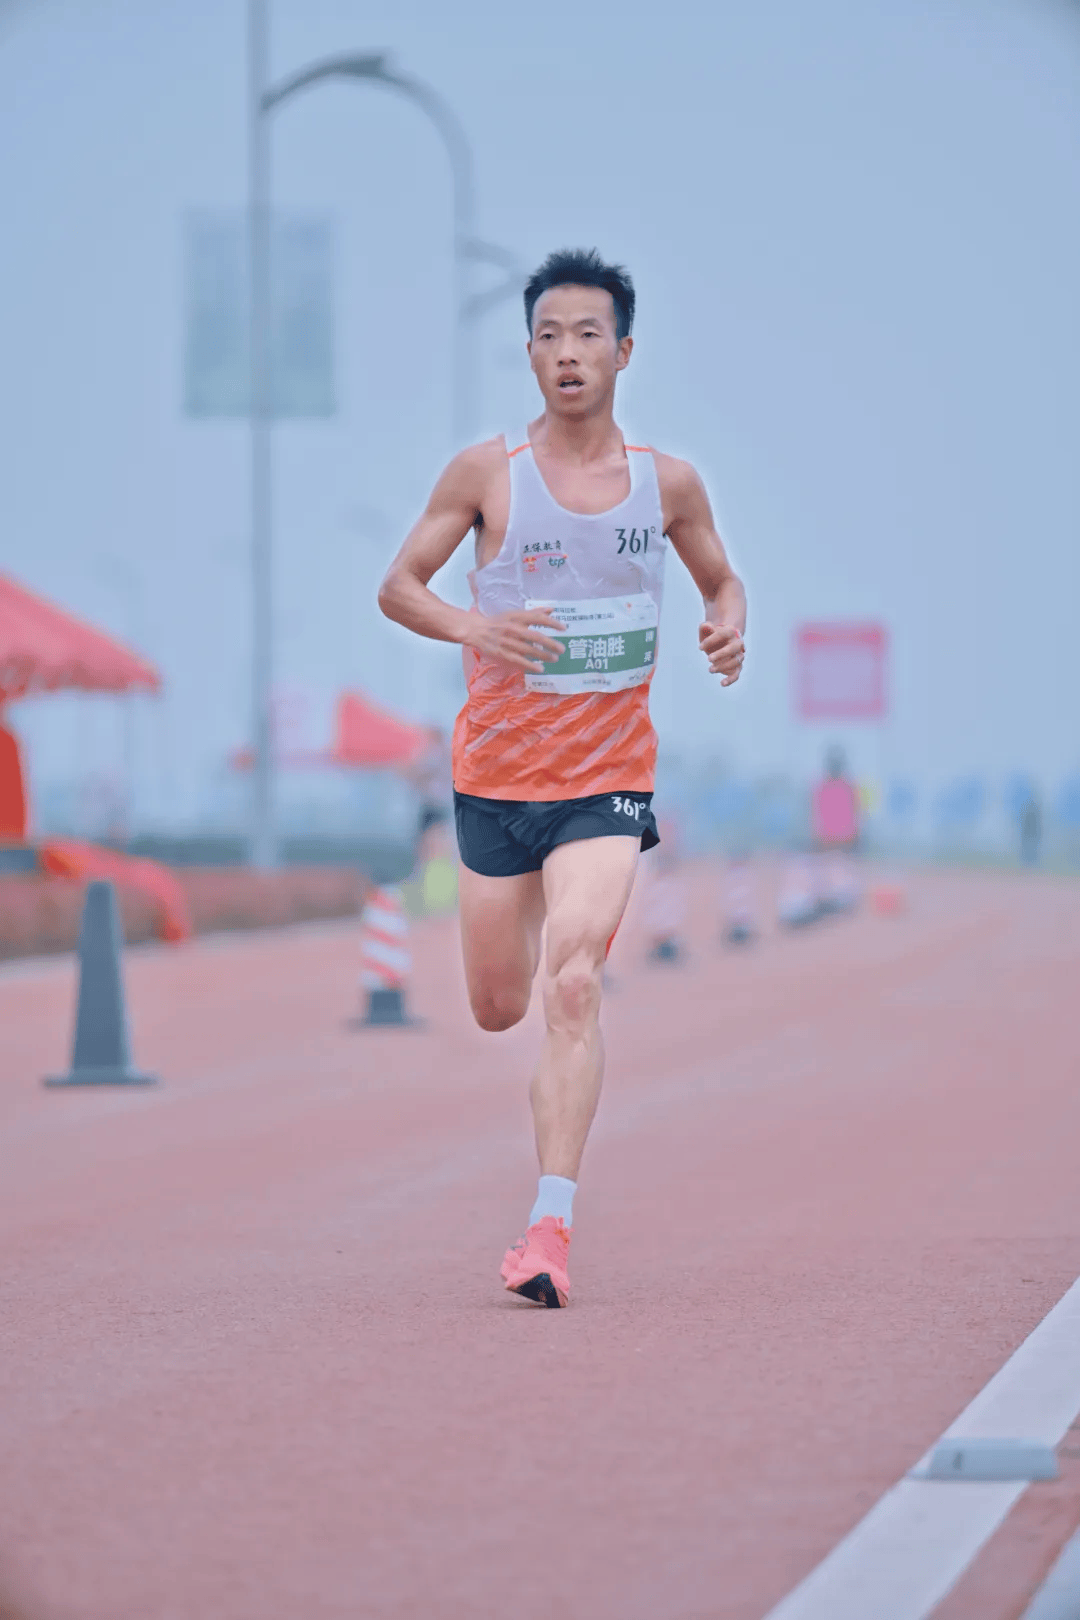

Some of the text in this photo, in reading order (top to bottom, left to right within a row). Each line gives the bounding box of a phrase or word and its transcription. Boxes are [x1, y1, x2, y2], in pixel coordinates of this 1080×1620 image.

[568, 635, 626, 660] 管油胜
[584, 658, 609, 670] A01
